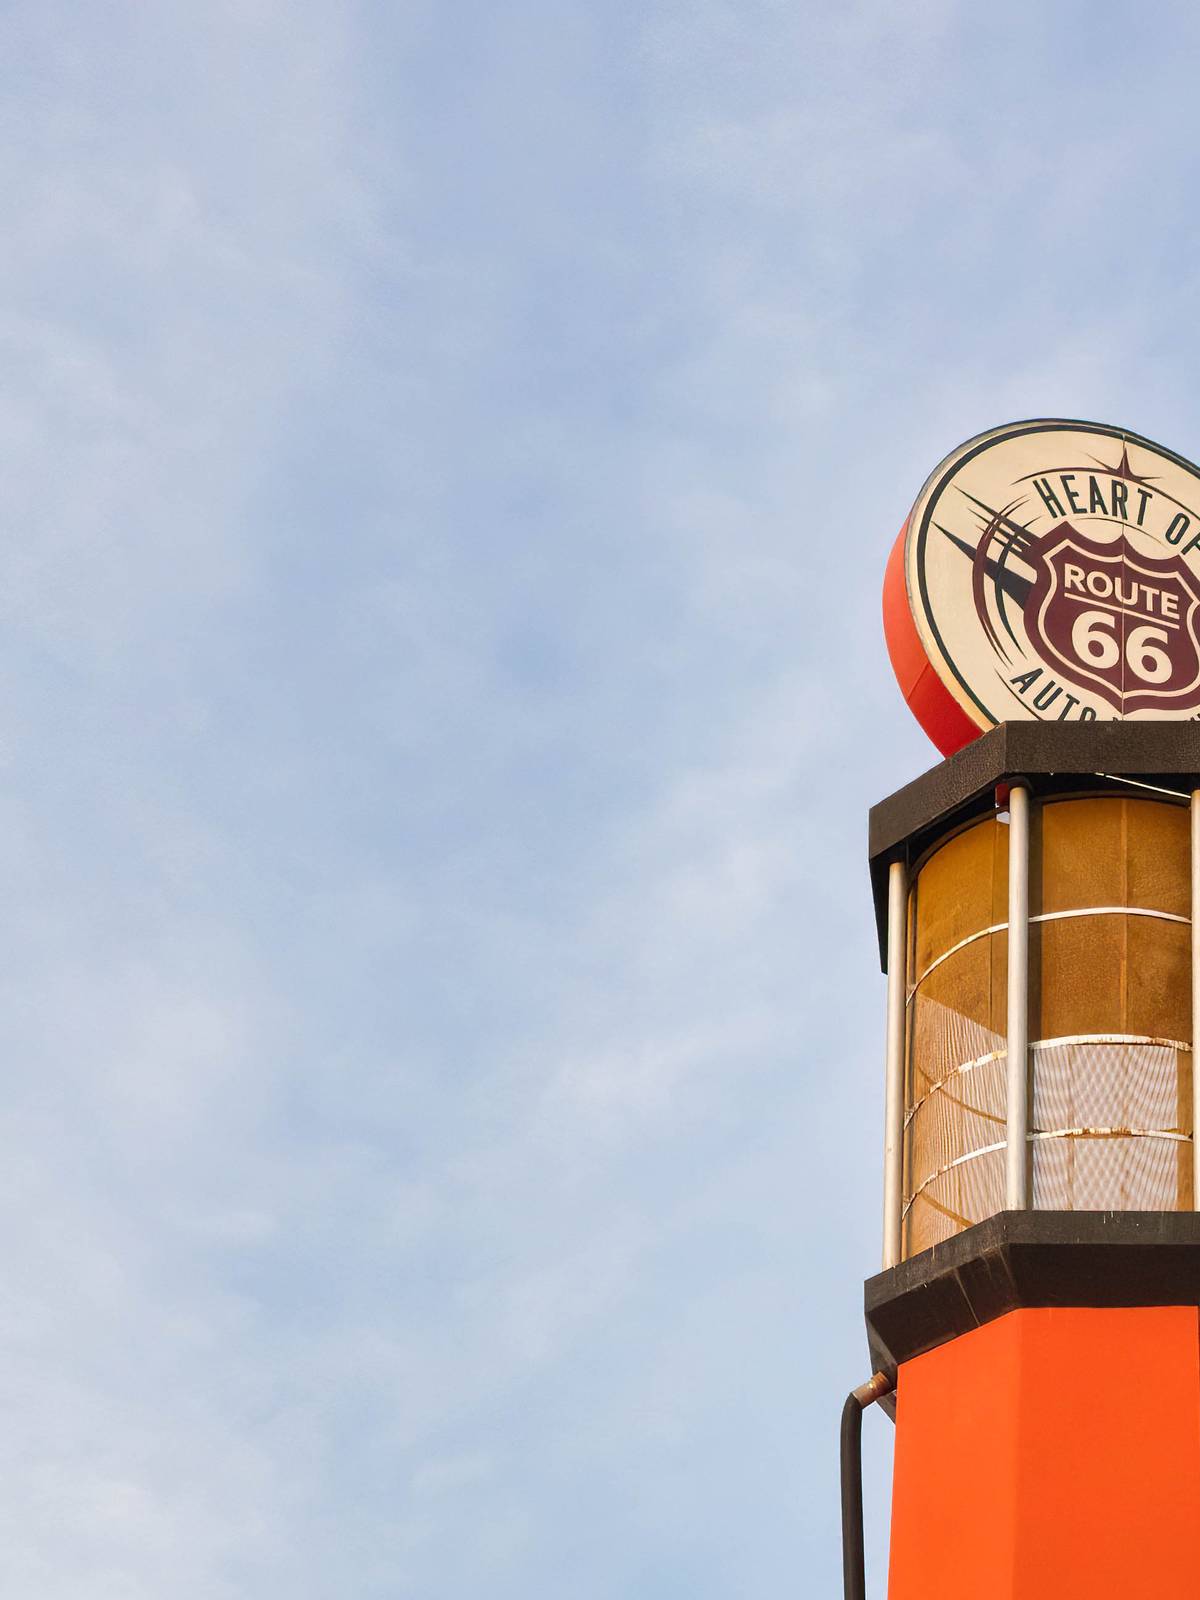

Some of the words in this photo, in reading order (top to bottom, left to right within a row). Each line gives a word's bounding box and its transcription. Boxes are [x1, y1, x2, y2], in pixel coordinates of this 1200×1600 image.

[1032, 474, 1153, 526] HEART
[1064, 563, 1179, 620] ROUTE
[1071, 610, 1174, 684] 66
